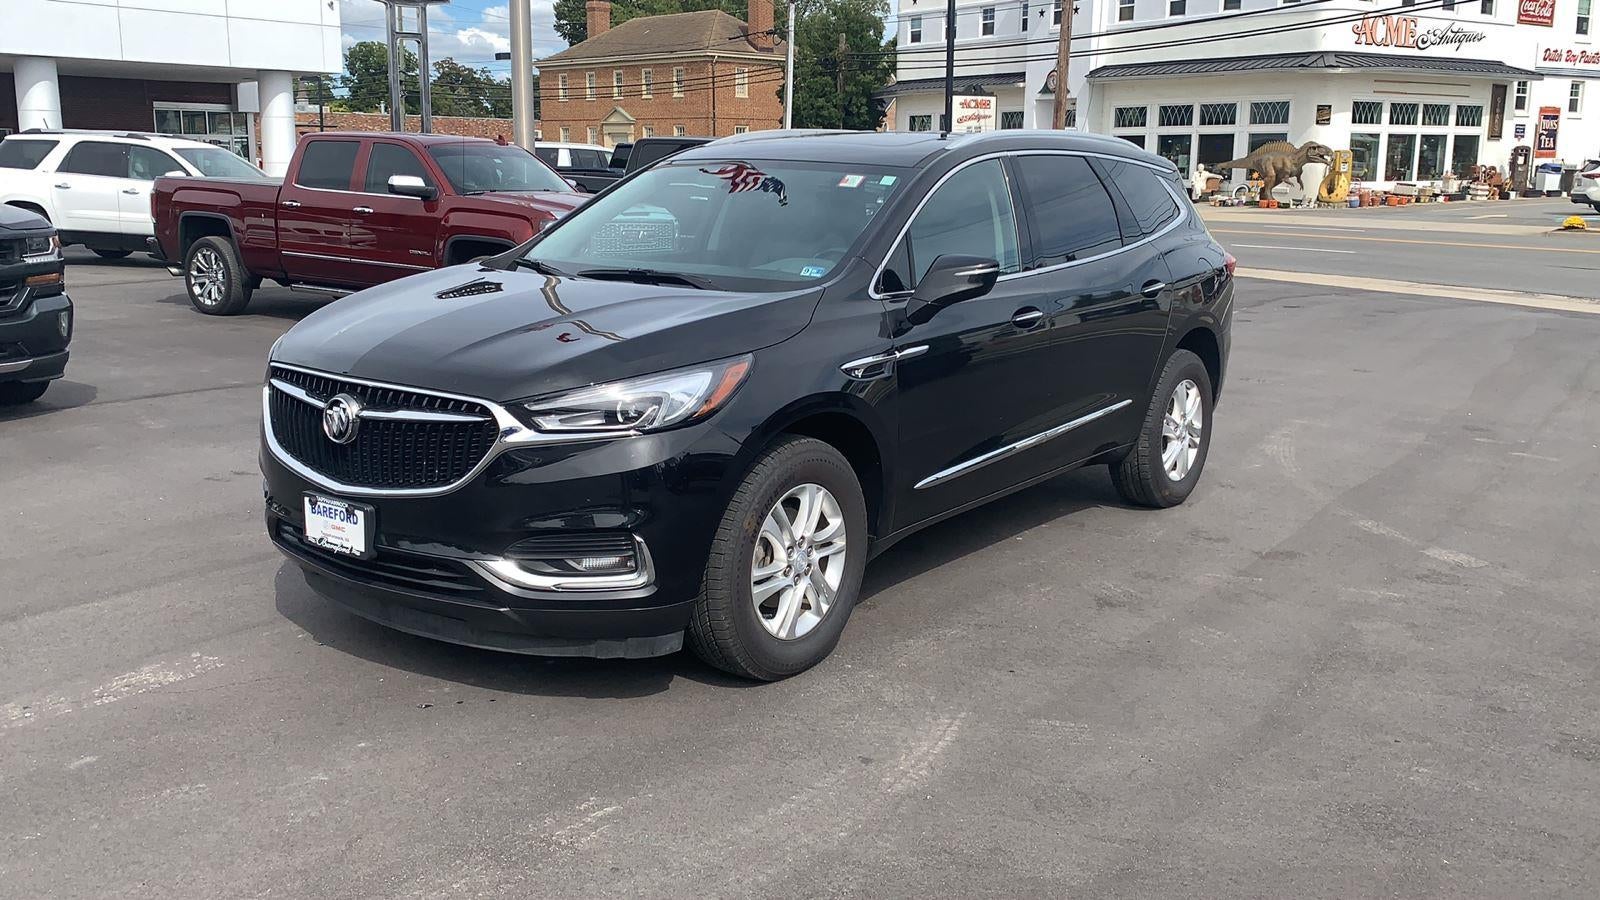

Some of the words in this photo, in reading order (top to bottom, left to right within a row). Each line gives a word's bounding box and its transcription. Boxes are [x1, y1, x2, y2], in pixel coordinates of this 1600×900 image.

[1352, 14, 1418, 48] ACME
[1416, 22, 1486, 52] Antiques
[1543, 48, 1563, 62] Dutch
[1565, 49, 1579, 66] Boy
[1579, 50, 1600, 65] Paints
[959, 98, 991, 109] ACME
[1540, 116, 1559, 134] LYONS
[1540, 135, 1555, 148] TEA
[311, 504, 358, 525] BAREFORD
[331, 524, 346, 532] GMC
